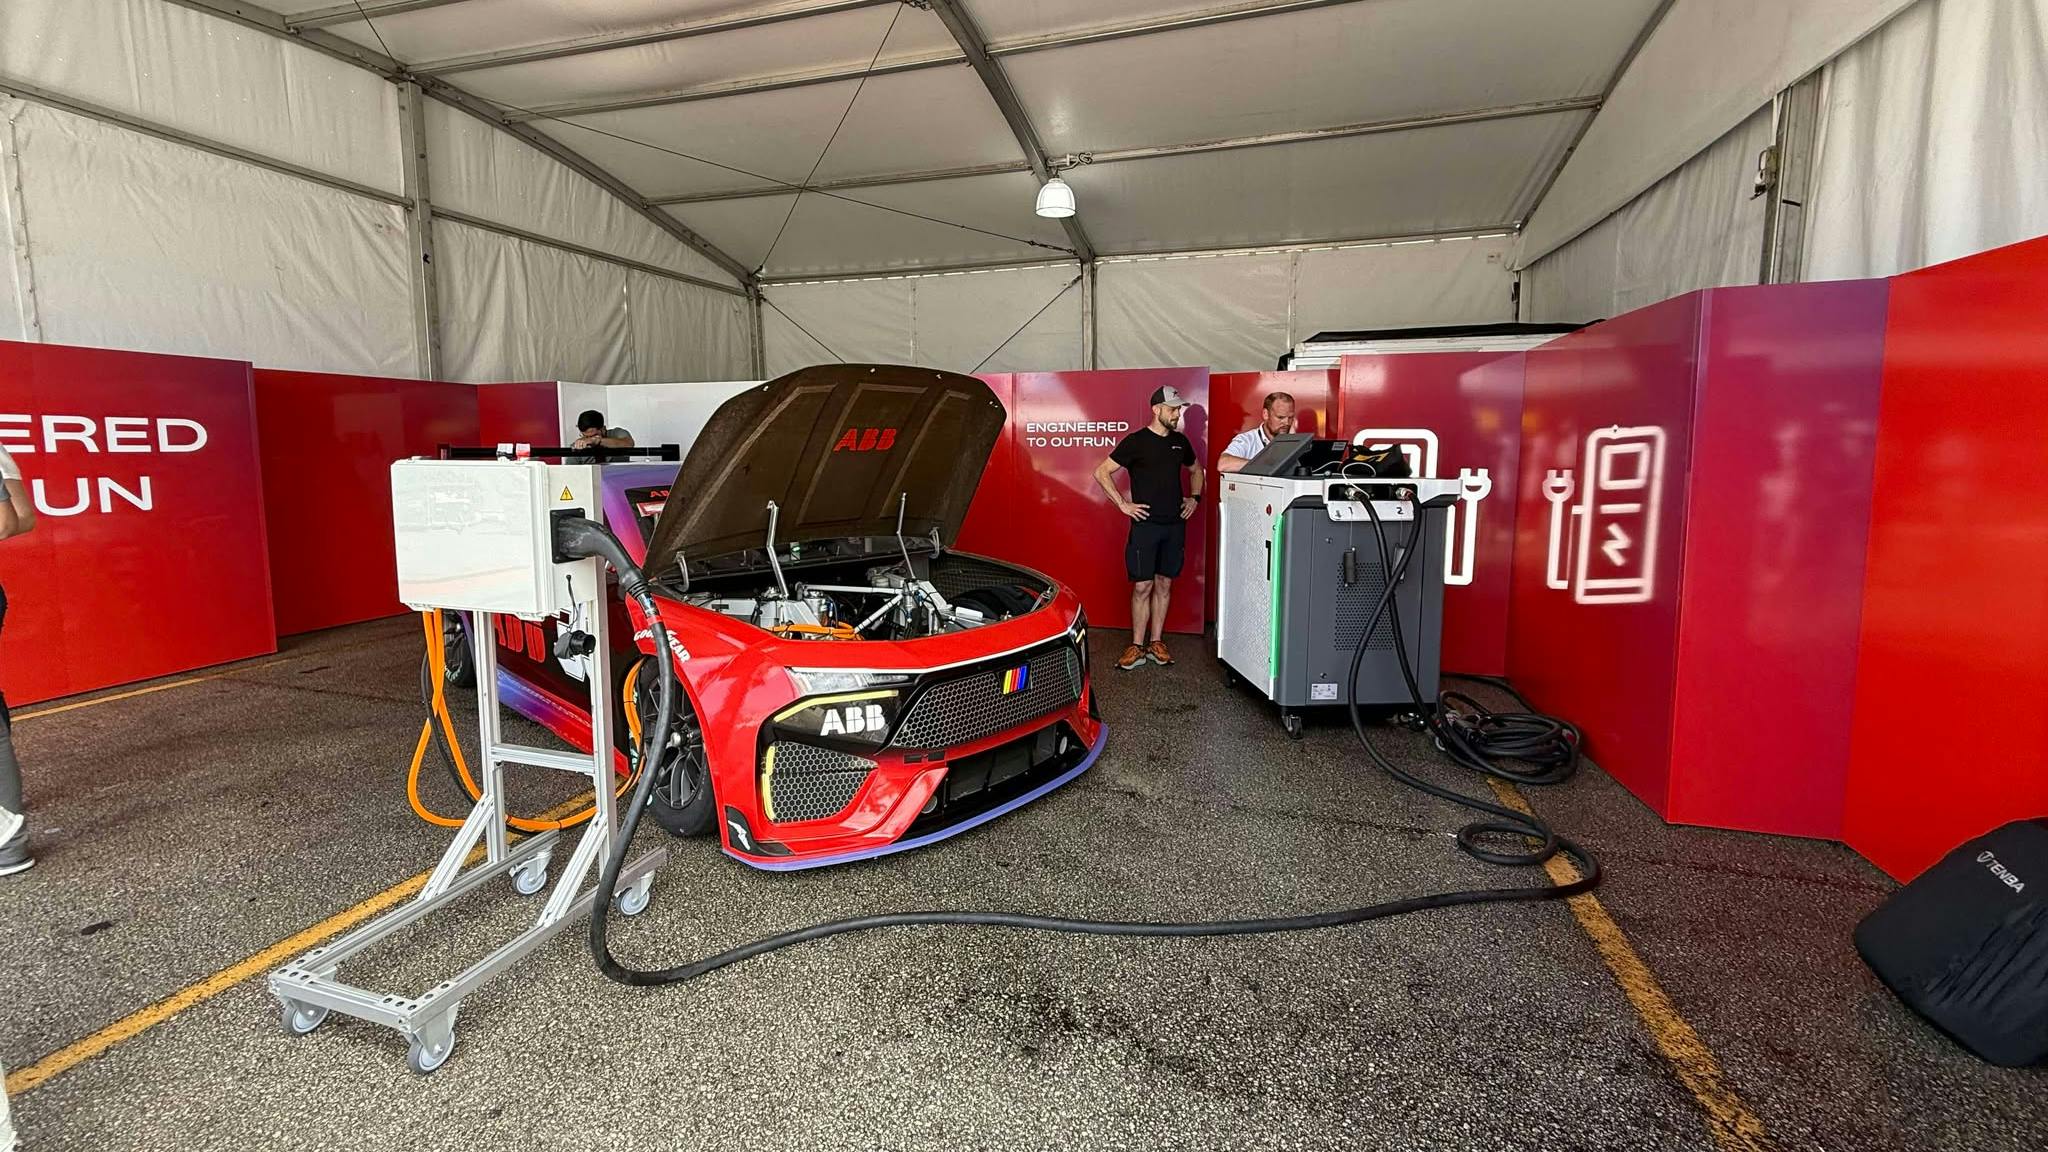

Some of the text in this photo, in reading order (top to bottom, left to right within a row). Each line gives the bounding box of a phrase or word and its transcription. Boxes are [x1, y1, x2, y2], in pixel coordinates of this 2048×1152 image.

[1026, 421, 1129, 433] ENGINEERED
[833, 428, 897, 452] ABB
[1026, 436, 1117, 448] TO OUTRUN
[1396, 506, 1404, 515] 2
[820, 704, 886, 736] ABB
[1986, 859, 2025, 893] TENBA
